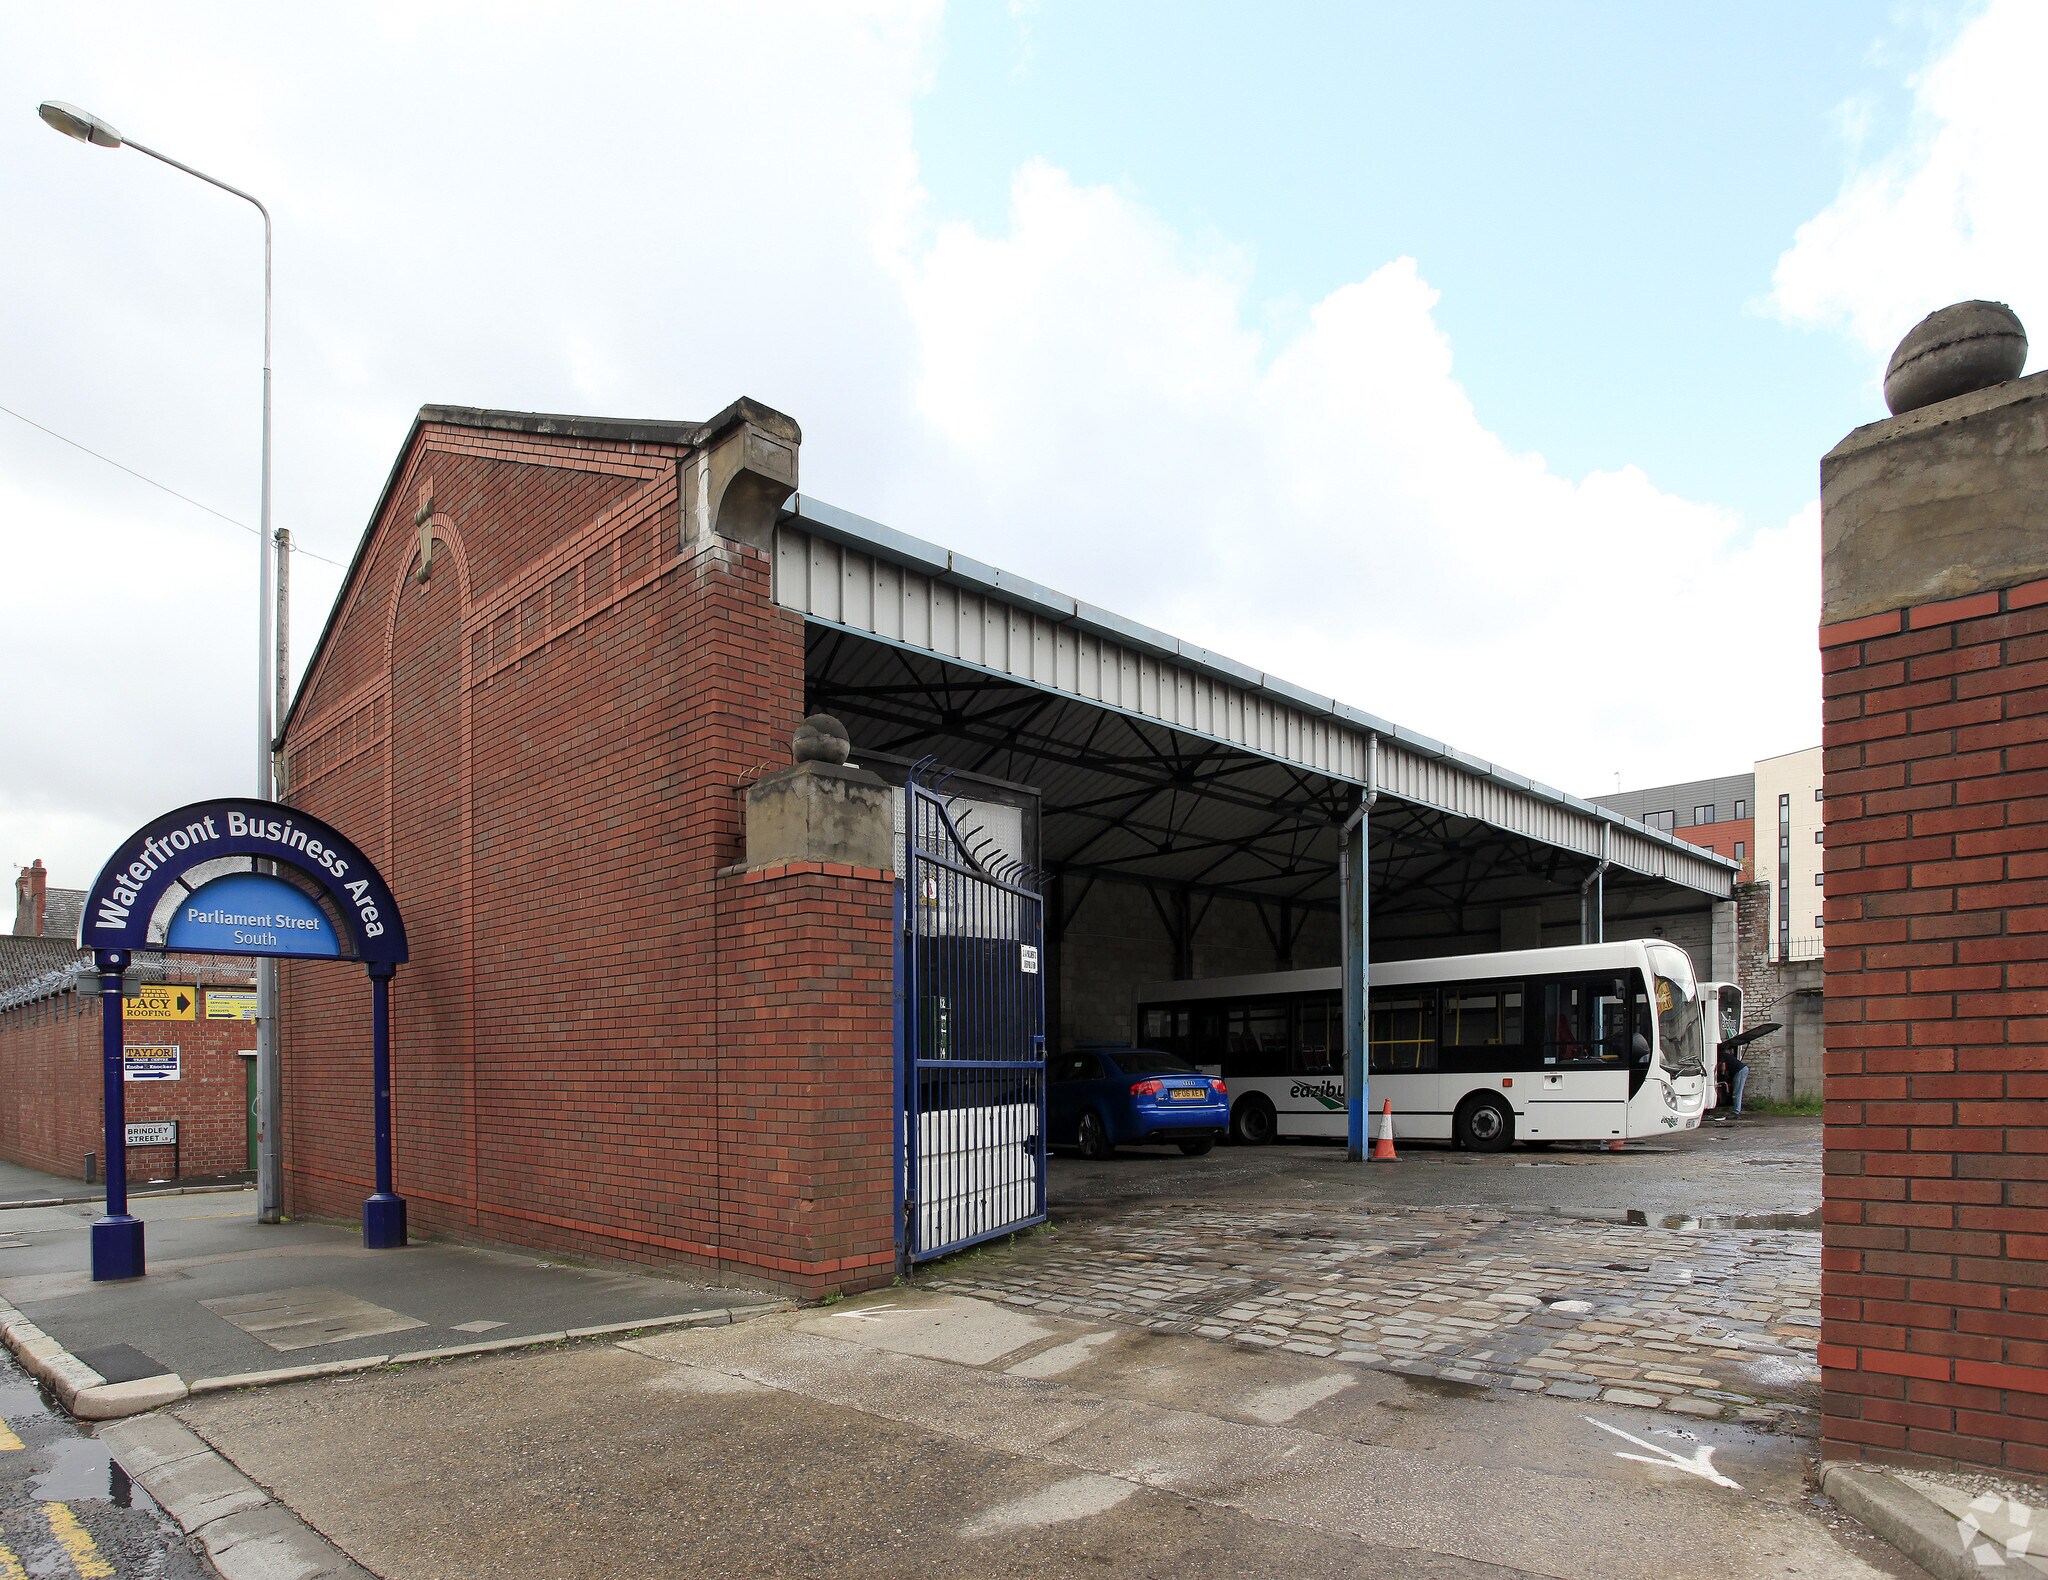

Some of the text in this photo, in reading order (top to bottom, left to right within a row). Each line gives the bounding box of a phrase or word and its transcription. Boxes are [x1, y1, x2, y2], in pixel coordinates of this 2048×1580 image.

[95, 811, 385, 939] Waterfront Business Area
[188, 908, 320, 930] Parliament Street
[234, 930, 277, 946] South
[126, 998, 171, 1009] LACY
[126, 1009, 171, 1017] ROOFING
[126, 1048, 172, 1057] TAYLOR
[1290, 1079, 1344, 1098] eazibu
[127, 1127, 168, 1135] BRINDLEY
[128, 1135, 160, 1143] STREET
